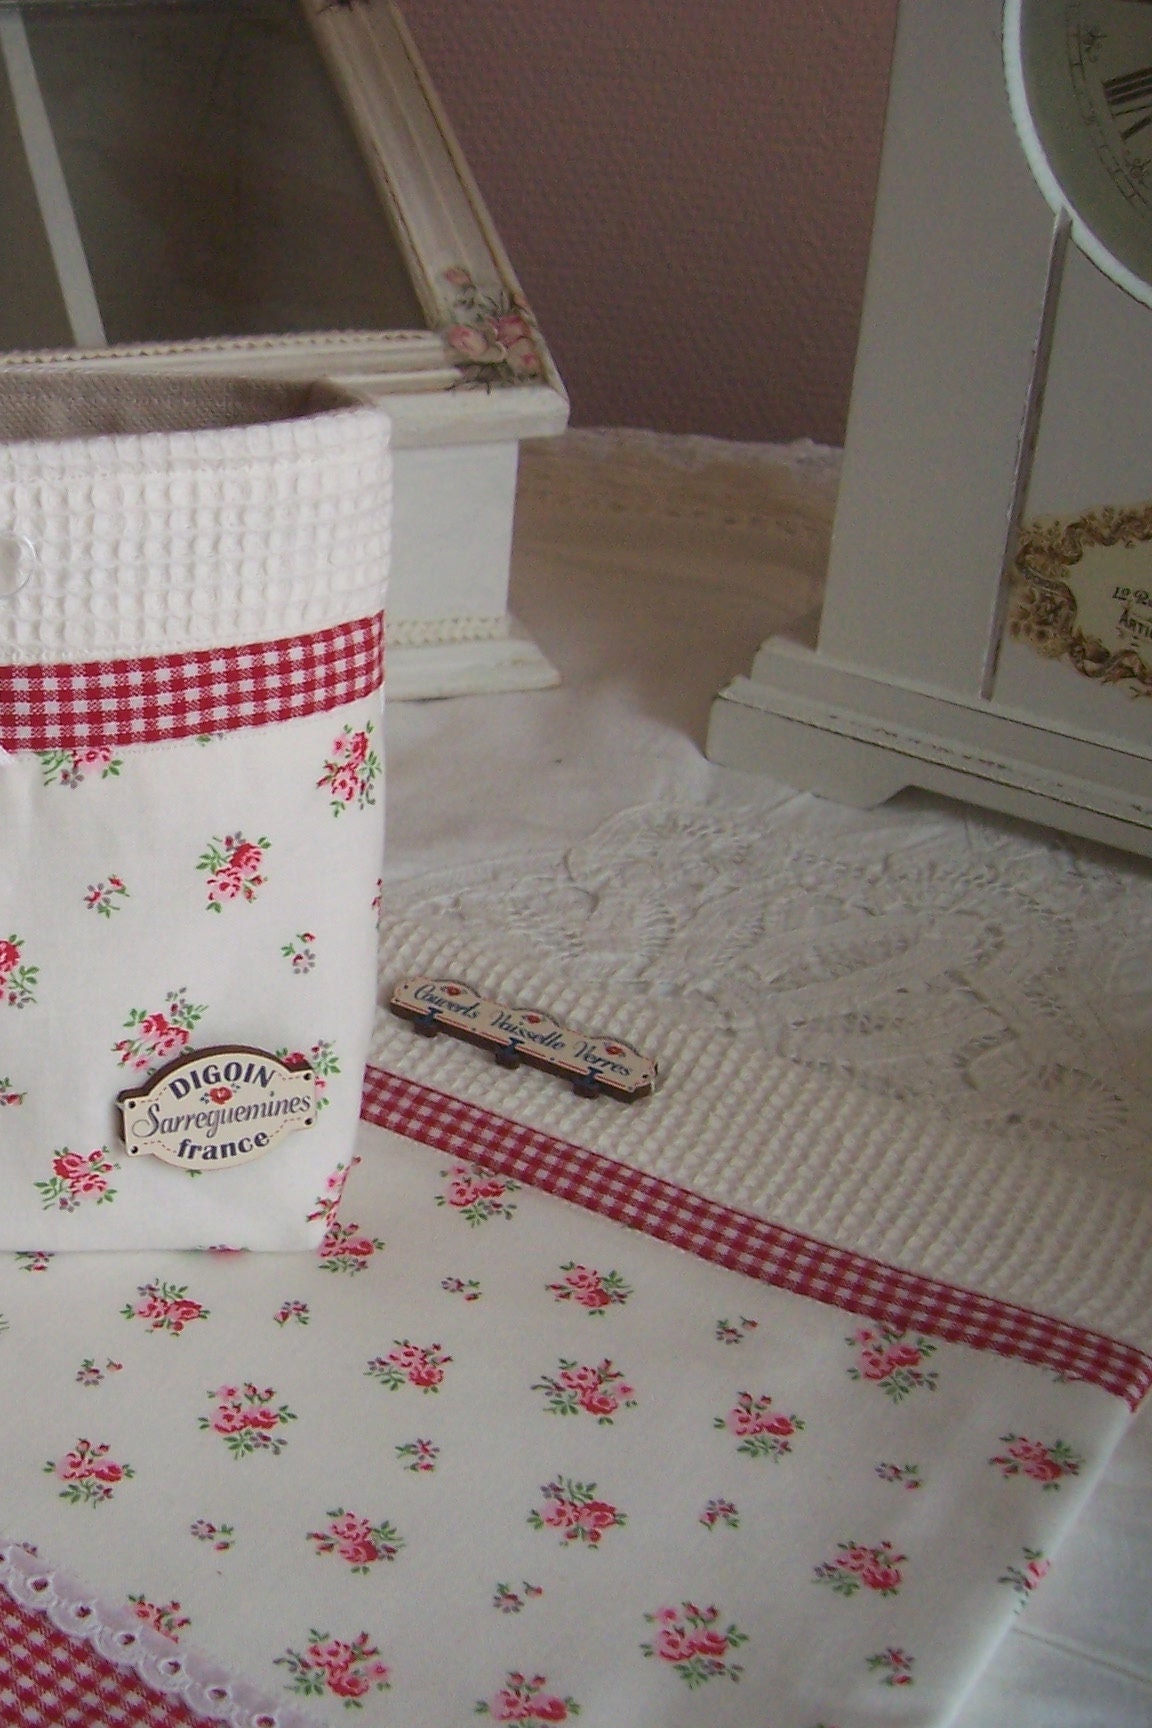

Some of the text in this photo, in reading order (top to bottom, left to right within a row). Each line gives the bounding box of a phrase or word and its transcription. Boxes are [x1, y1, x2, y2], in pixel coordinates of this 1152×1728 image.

[490, 1010, 566, 1050] Vaisselle
[574, 1040, 633, 1077] Verres
[169, 1061, 276, 1100] DIGOIN
[132, 1090, 311, 1138] Sarreguemines
[176, 1131, 270, 1160] france
